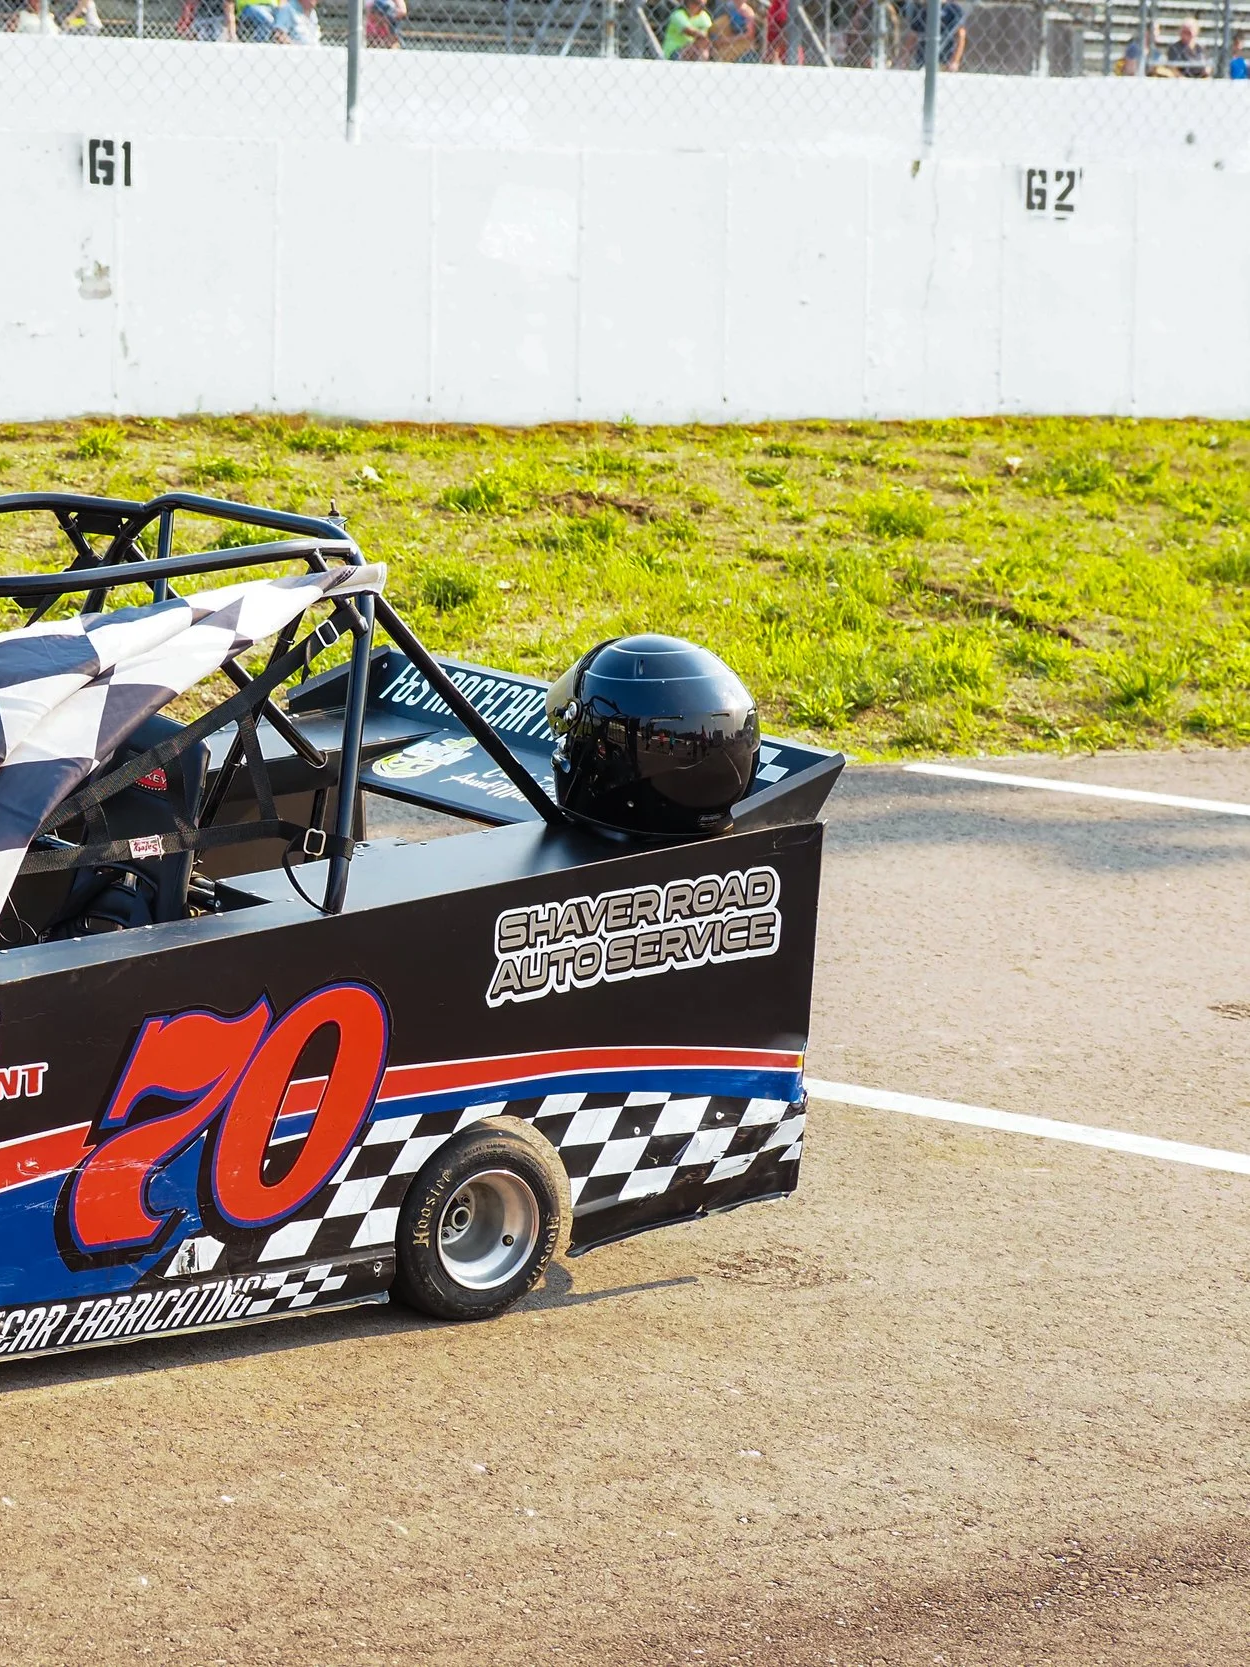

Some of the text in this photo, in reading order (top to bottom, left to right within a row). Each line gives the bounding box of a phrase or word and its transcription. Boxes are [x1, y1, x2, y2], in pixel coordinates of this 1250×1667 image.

[498, 870, 776, 952] SHAVER ROAD
[490, 912, 777, 998] AUTO SERVICE
[70, 982, 389, 1252] 70
[56, 1275, 260, 1346] FABRICATING
